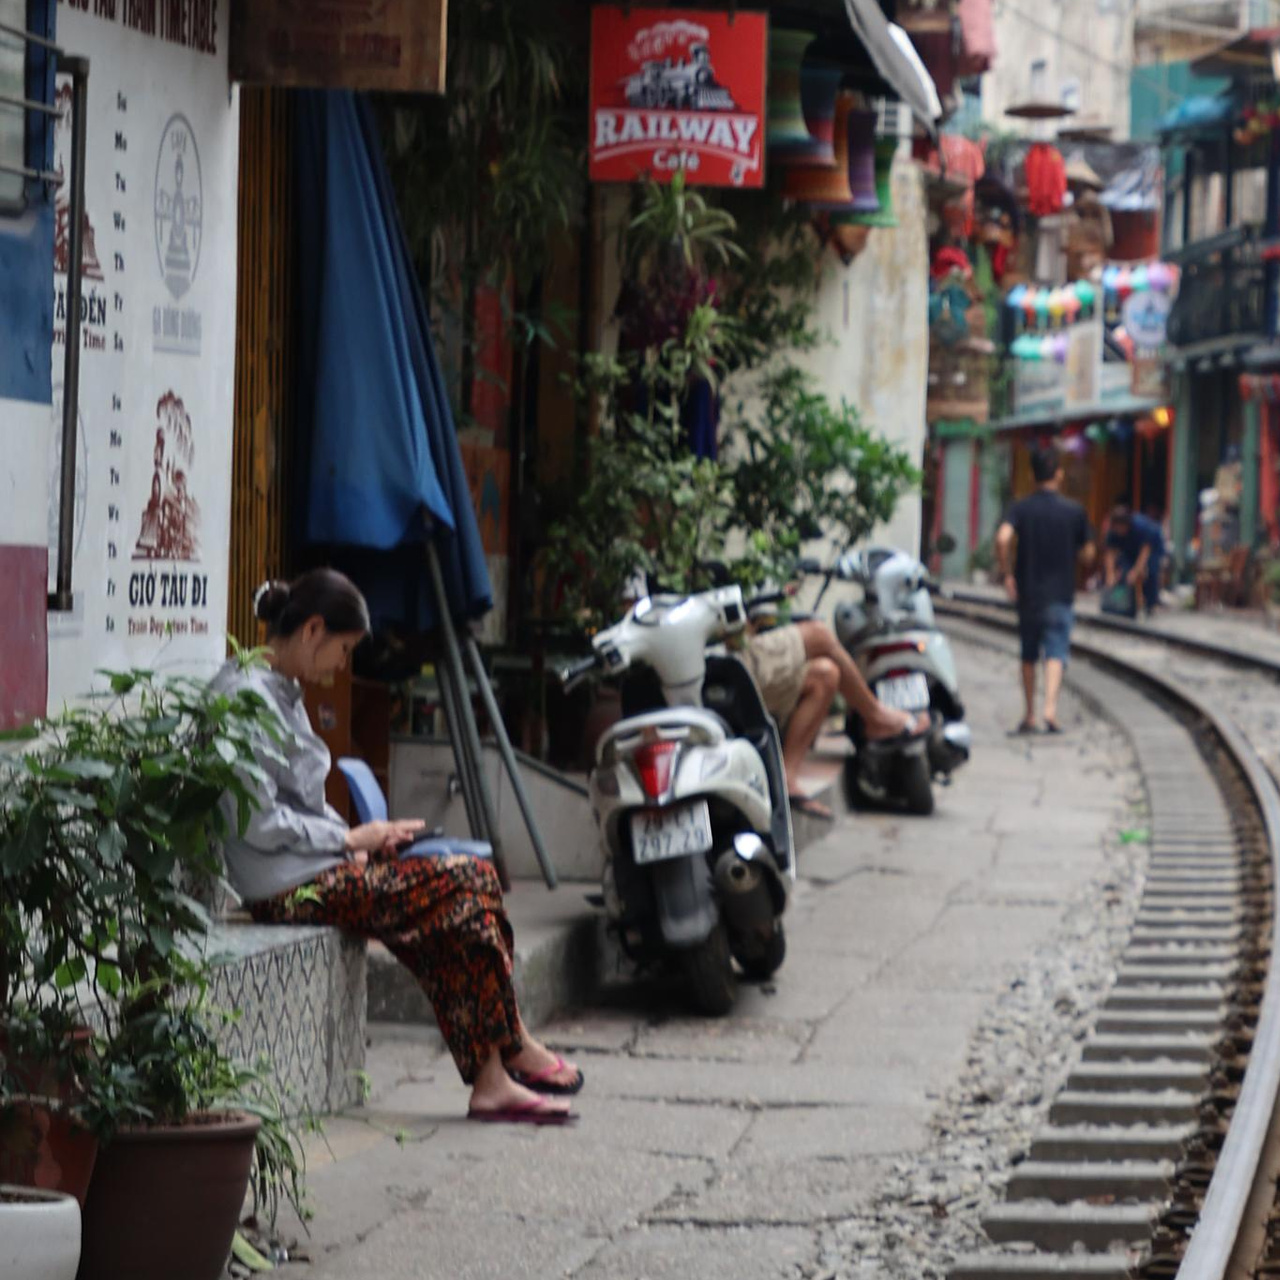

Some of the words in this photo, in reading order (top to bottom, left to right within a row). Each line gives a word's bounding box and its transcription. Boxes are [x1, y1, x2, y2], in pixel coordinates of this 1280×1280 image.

[595, 111, 757, 154] RAILWAY
[83, 327, 105, 351] Time
[129, 562, 157, 608] GIỜ
[160, 564, 188, 608] TÀU
[128, 617, 148, 636] Train
[150, 616, 188, 639] Depture
[190, 616, 208, 635] Time
